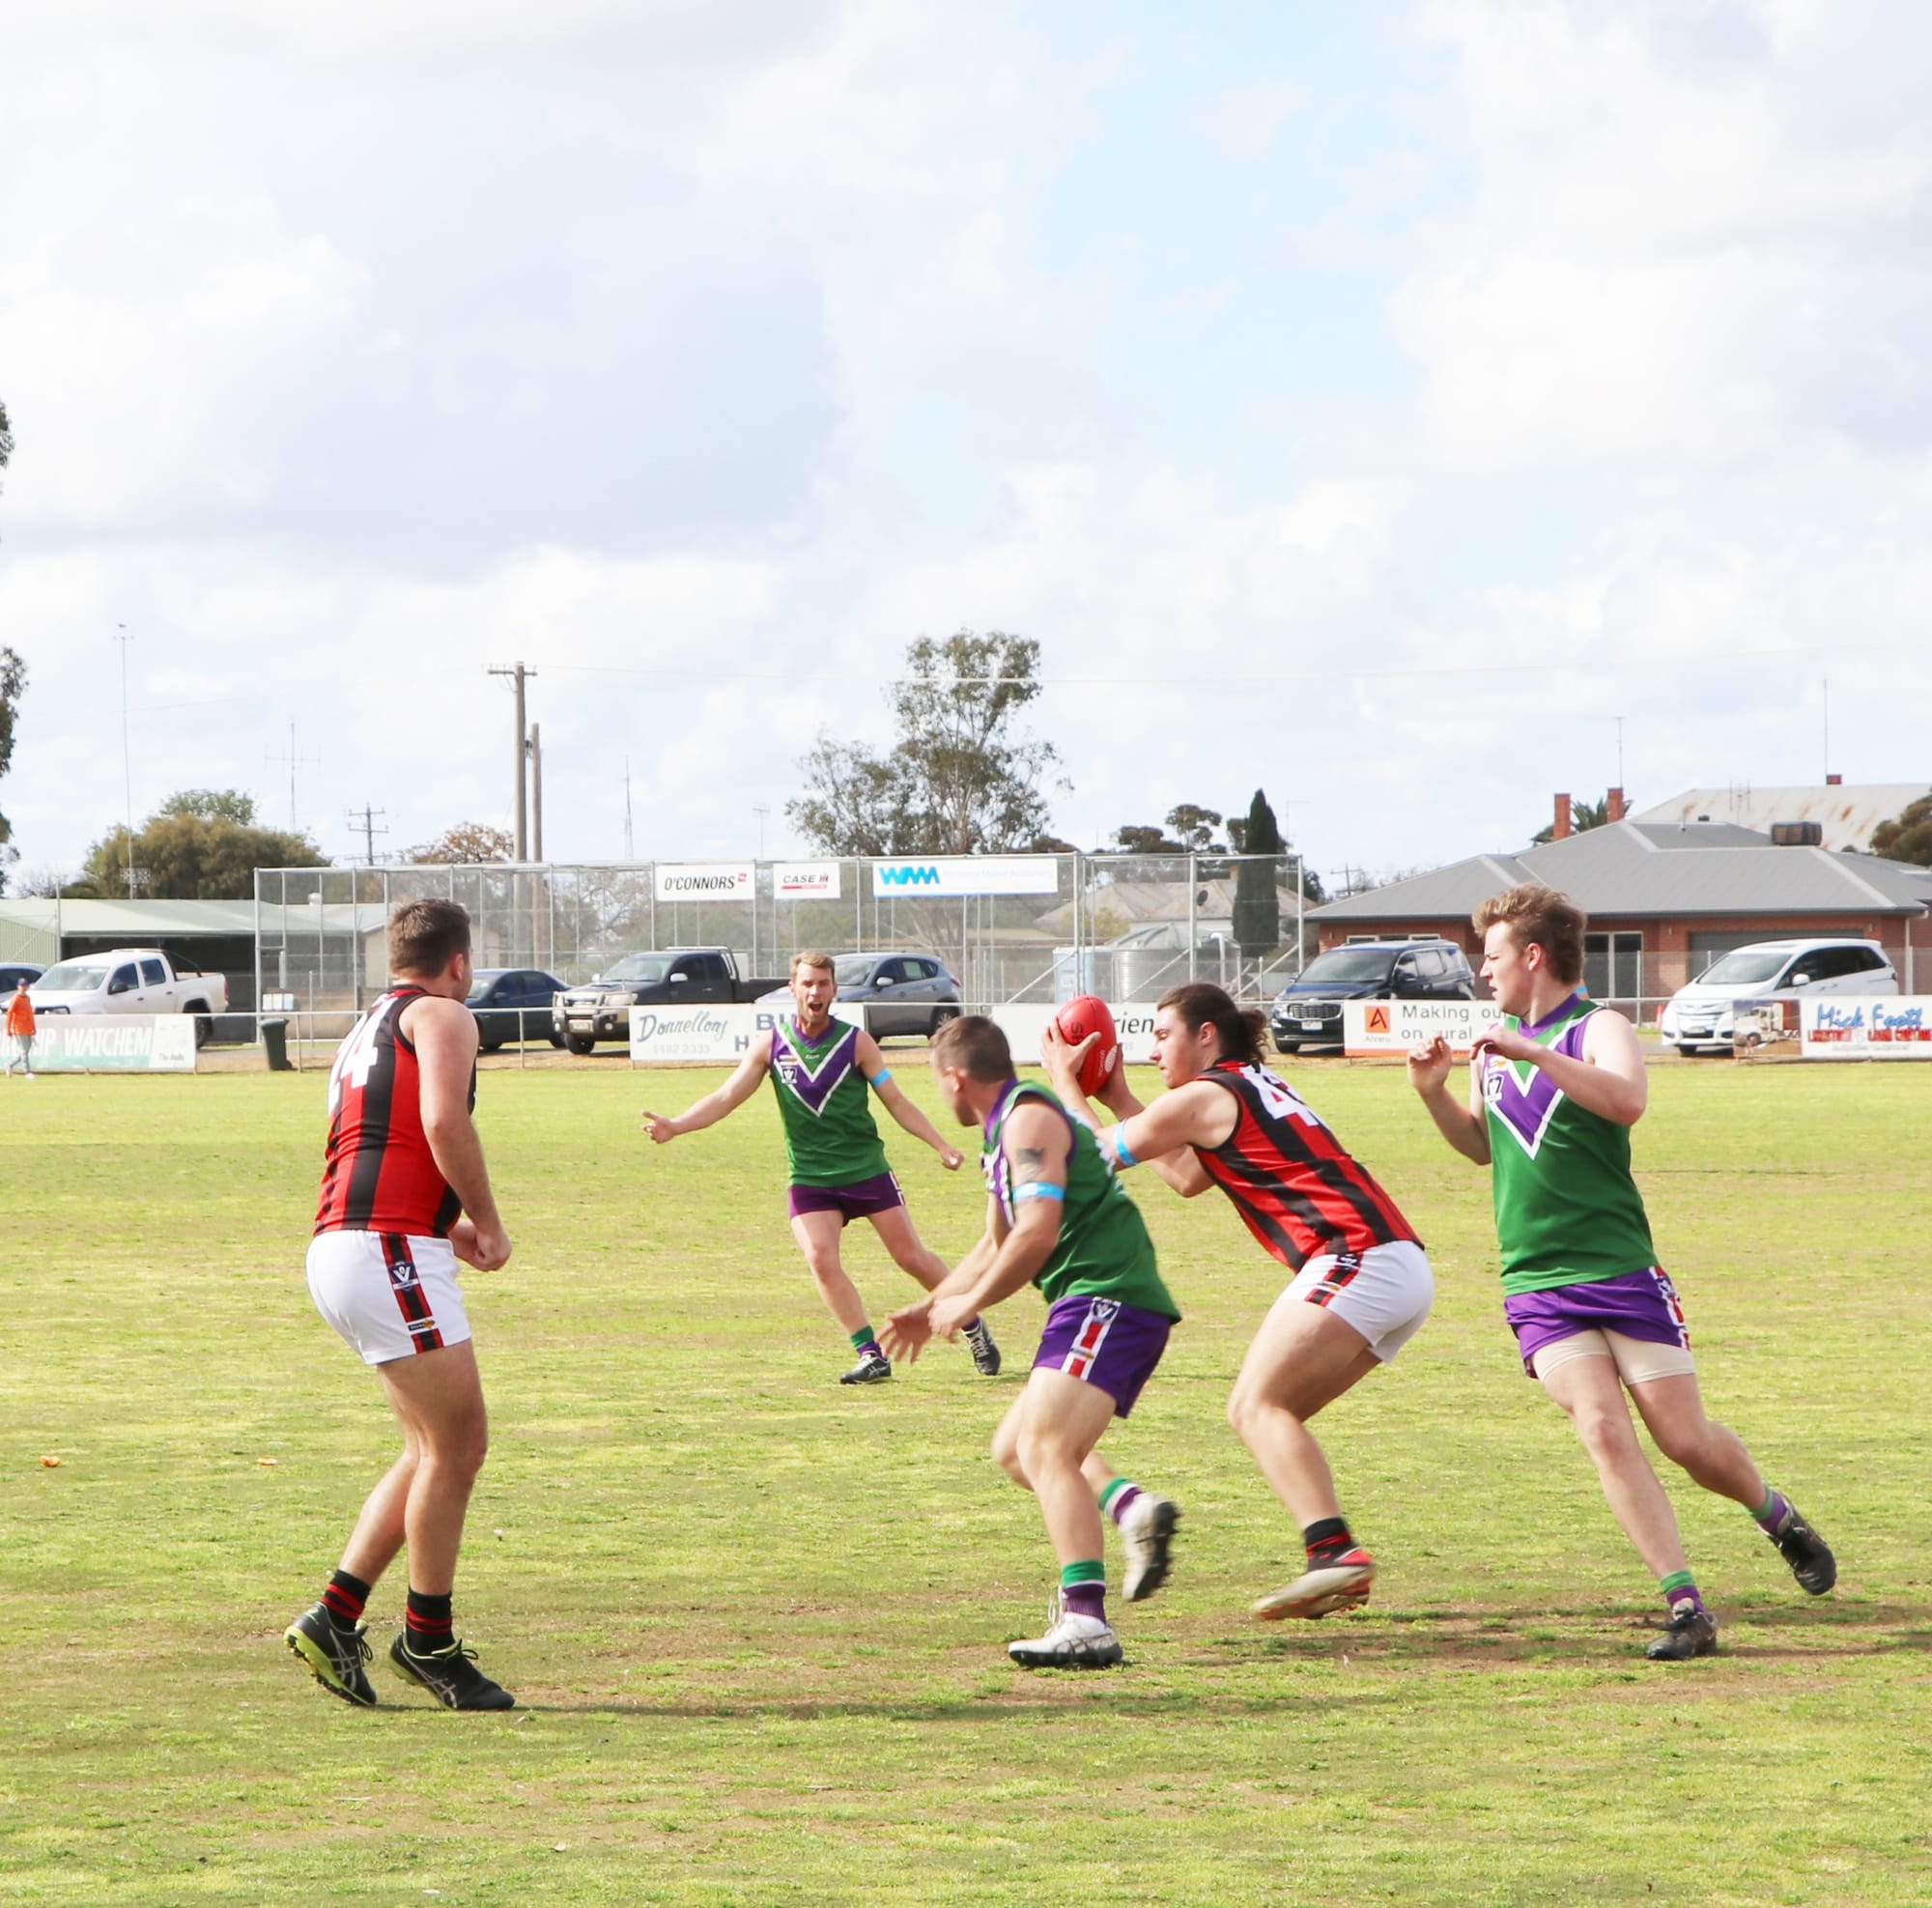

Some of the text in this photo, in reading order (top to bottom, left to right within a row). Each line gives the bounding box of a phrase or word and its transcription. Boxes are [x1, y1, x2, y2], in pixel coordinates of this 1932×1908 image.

[665, 875, 735, 891] O'CONNORS
[782, 873, 815, 884] CASE
[1402, 1005, 1469, 1022] Making
[65, 1027, 153, 1058] WATCHEM
